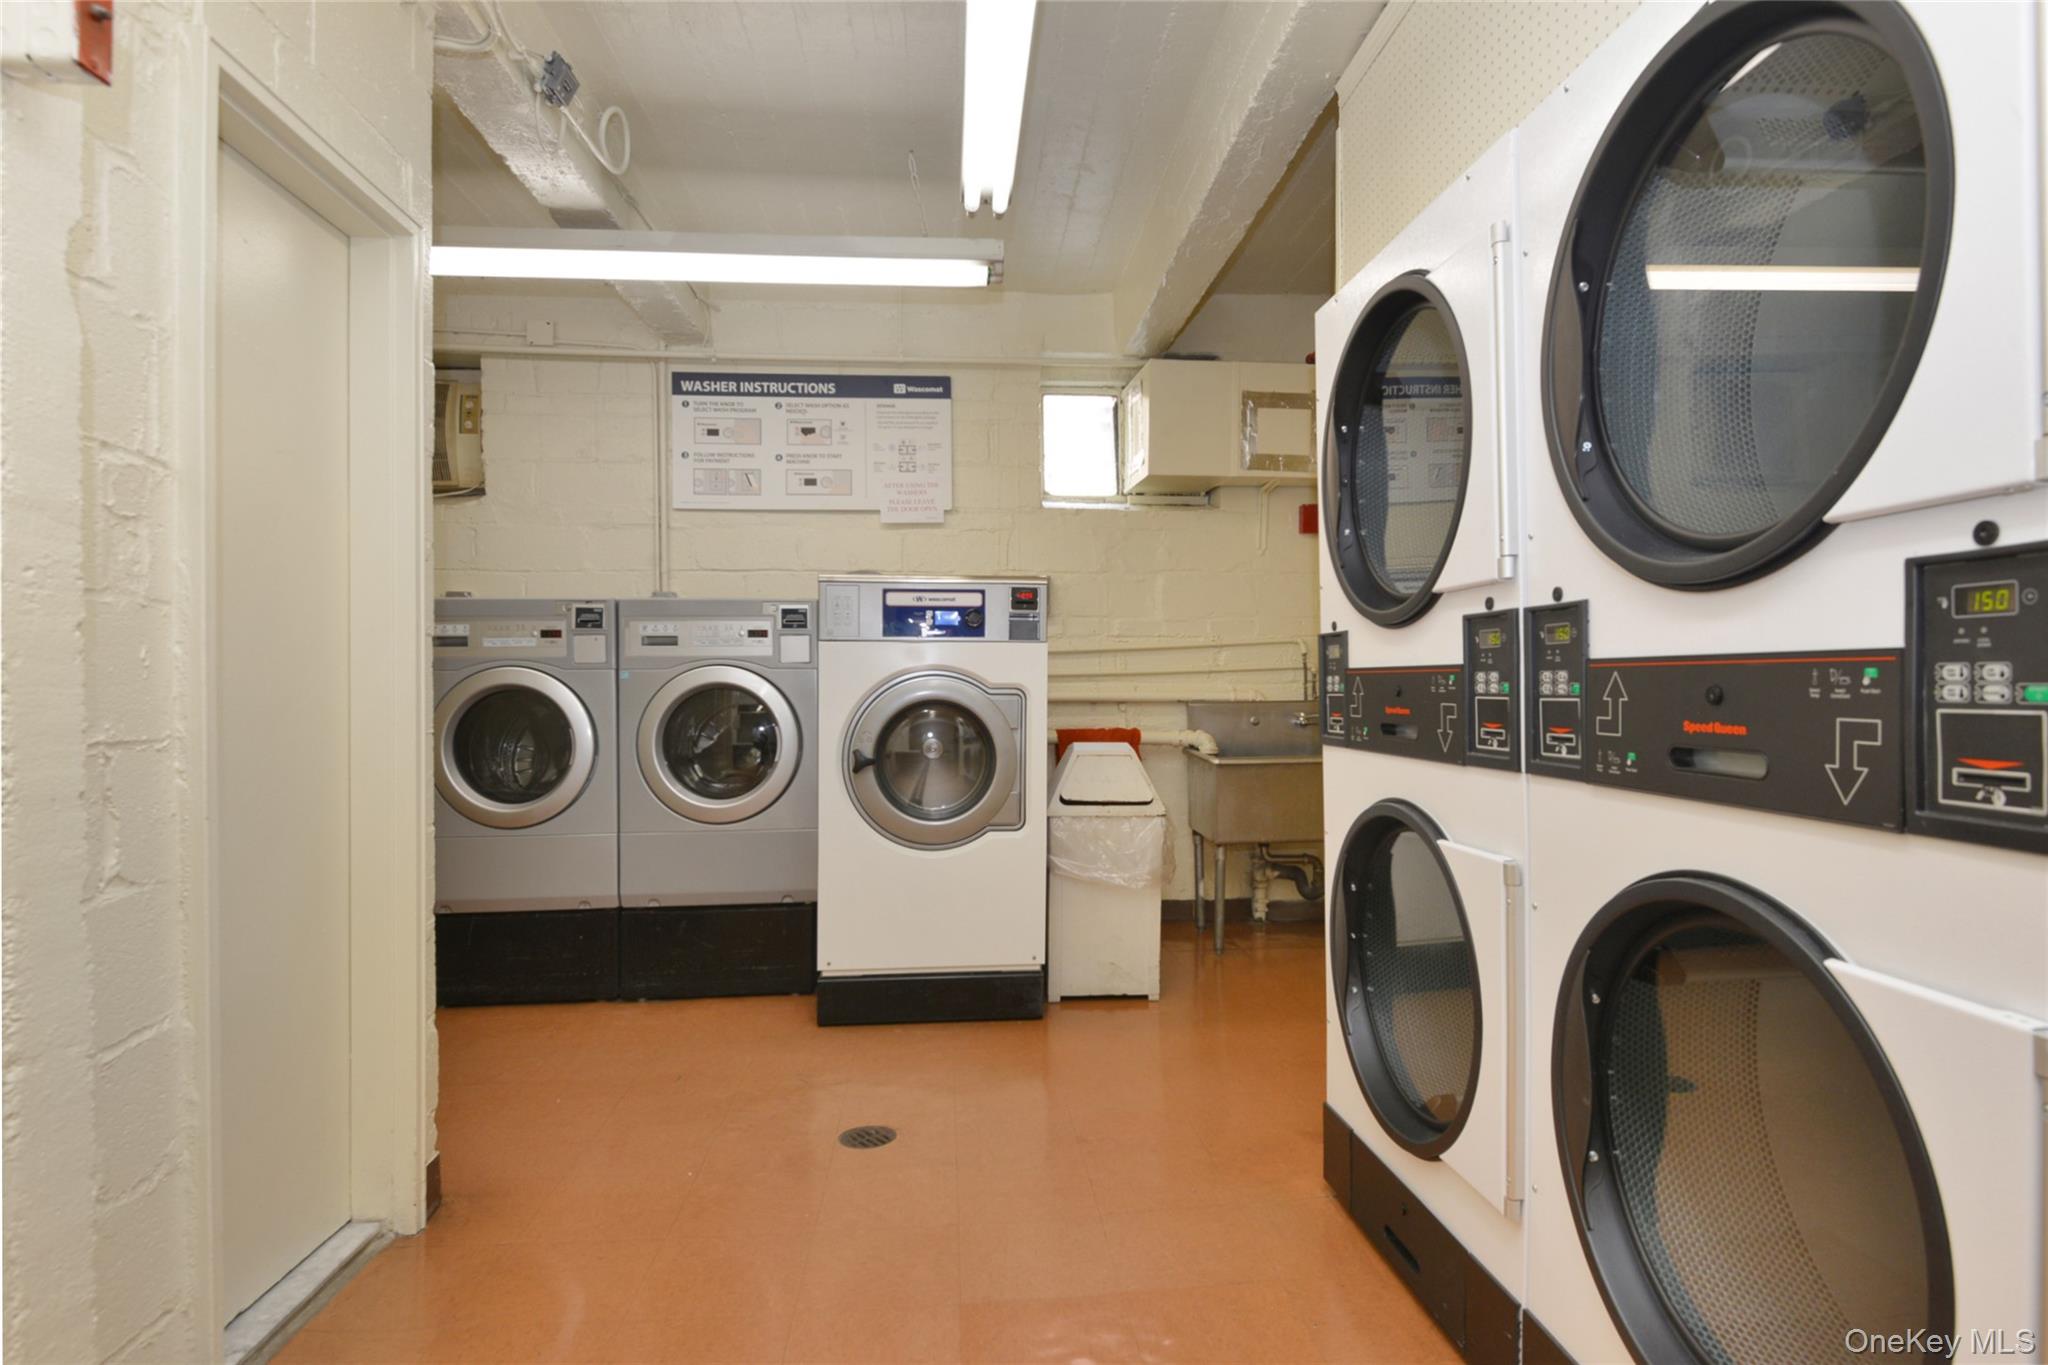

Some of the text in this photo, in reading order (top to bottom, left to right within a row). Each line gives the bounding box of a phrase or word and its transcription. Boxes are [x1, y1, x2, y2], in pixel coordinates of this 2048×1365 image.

[680, 380, 837, 394] WASHER INSTRUCTIONS
[1973, 589, 2009, 612] 150
[1683, 720, 1747, 736] Speed Queen
